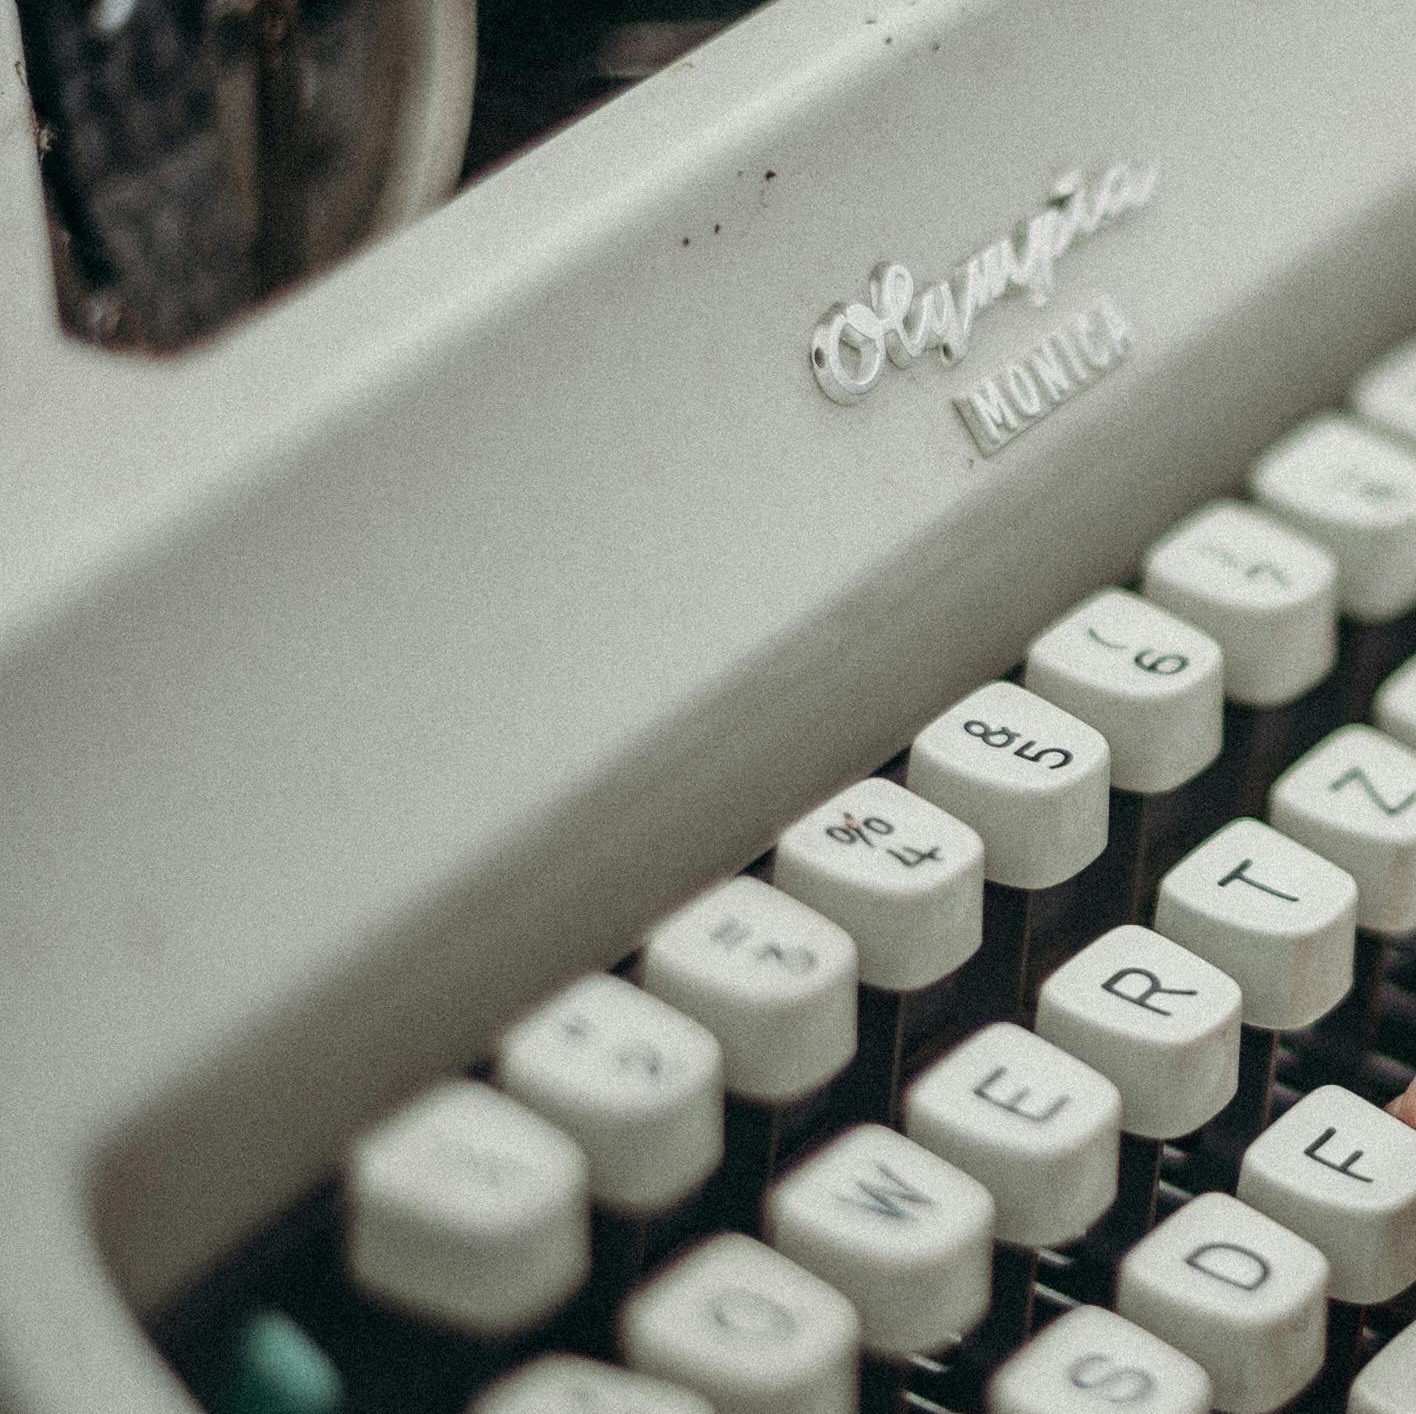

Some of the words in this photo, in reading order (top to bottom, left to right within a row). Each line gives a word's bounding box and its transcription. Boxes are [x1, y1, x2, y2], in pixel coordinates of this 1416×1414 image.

[809, 157, 1161, 406] Olympia
[1132, 648, 1190, 676] 6
[961, 718, 1020, 750] &
[1012, 738, 1075, 771] 5
[824, 810, 896, 849] %
[886, 843, 944, 869] 4
[1216, 857, 1300, 903] T
[1100, 966, 1198, 1017] R
[972, 1065, 1072, 1124] E
[1303, 1126, 1374, 1184] F
[833, 1159, 936, 1224] W
[1184, 1241, 1271, 1292] D
[1067, 1352, 1160, 1405] S
